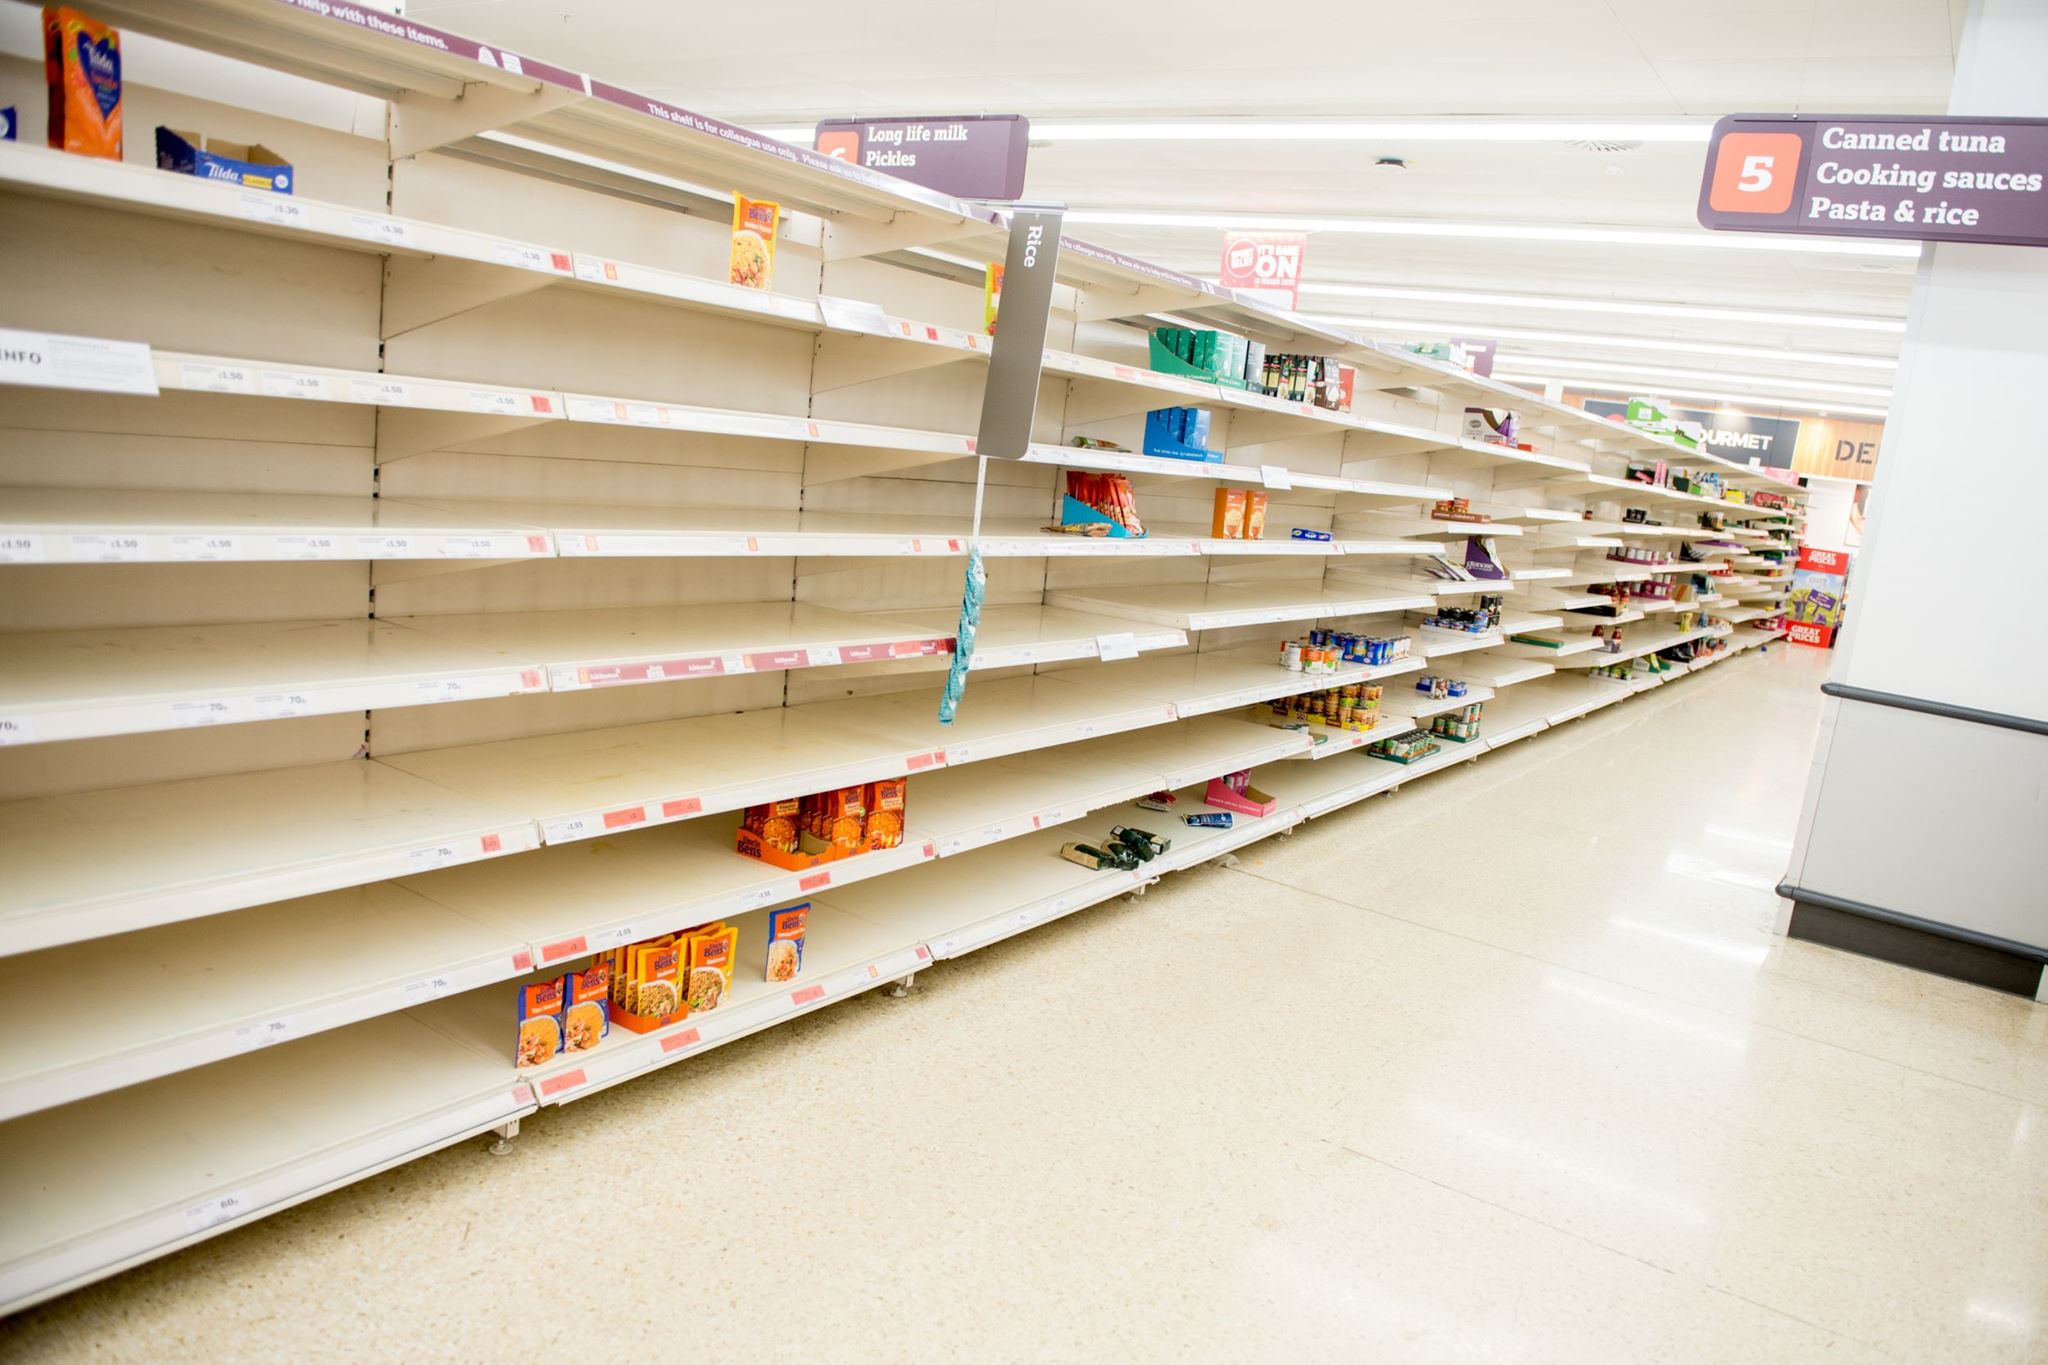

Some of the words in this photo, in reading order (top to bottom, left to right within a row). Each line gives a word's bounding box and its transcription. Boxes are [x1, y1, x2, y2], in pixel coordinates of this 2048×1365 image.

[332, 6, 366, 25] with
[366, 14, 406, 37] these
[406, 26, 449, 51] items.
[648, 103, 670, 120] This
[670, 108, 694, 128] shelf
[695, 118, 704, 130] is
[704, 120, 718, 135] for
[719, 127, 761, 149] colleague
[867, 126, 903, 145] Long
[905, 126, 931, 142] life
[933, 126, 968, 142] milk
[1822, 127, 1931, 152] Canned
[1938, 129, 2007, 154] tuna
[204, 161, 239, 182] Tilda
[865, 150, 917, 167] Pickles
[1737, 155, 1774, 193] 5
[1816, 162, 1937, 194] Cooking
[1943, 169, 2044, 193] sauces
[1808, 196, 1887, 223] Pasta
[1893, 198, 1916, 224] &
[1922, 200, 1981, 227] rice
[1023, 225, 1043, 268] Rice
[1255, 255, 1299, 279] ON
[1697, 427, 1774, 451] OURMET
[1834, 439, 1876, 465] DE
[1810, 550, 1837, 560] GREAT
[1791, 624, 1821, 636] GREAT
